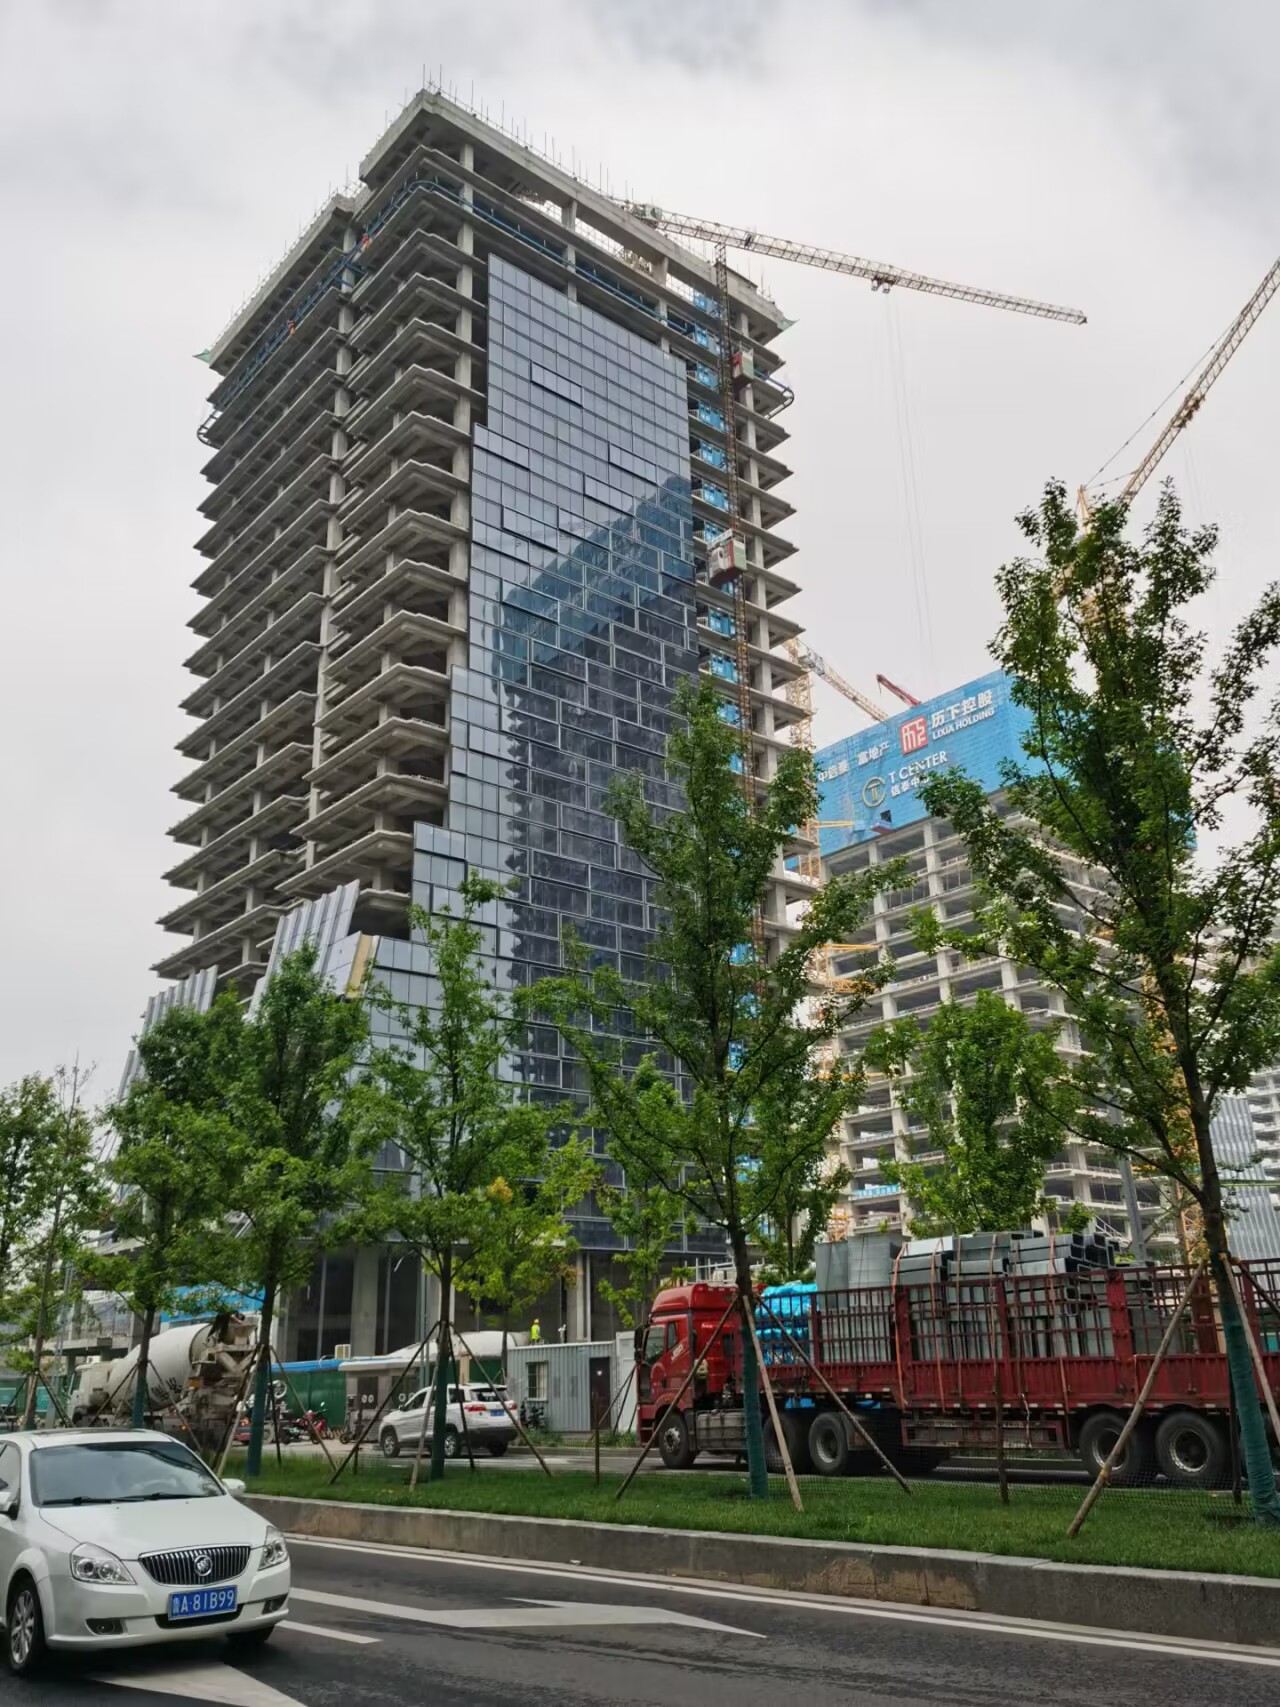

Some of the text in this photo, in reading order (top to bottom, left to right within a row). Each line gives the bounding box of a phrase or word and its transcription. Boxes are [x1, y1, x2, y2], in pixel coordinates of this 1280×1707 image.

[931, 689, 992, 729] 历下控股
[932, 722, 955, 740] LIXIA
[955, 707, 995, 731] HOLDING
[888, 751, 949, 784] T CENTER
